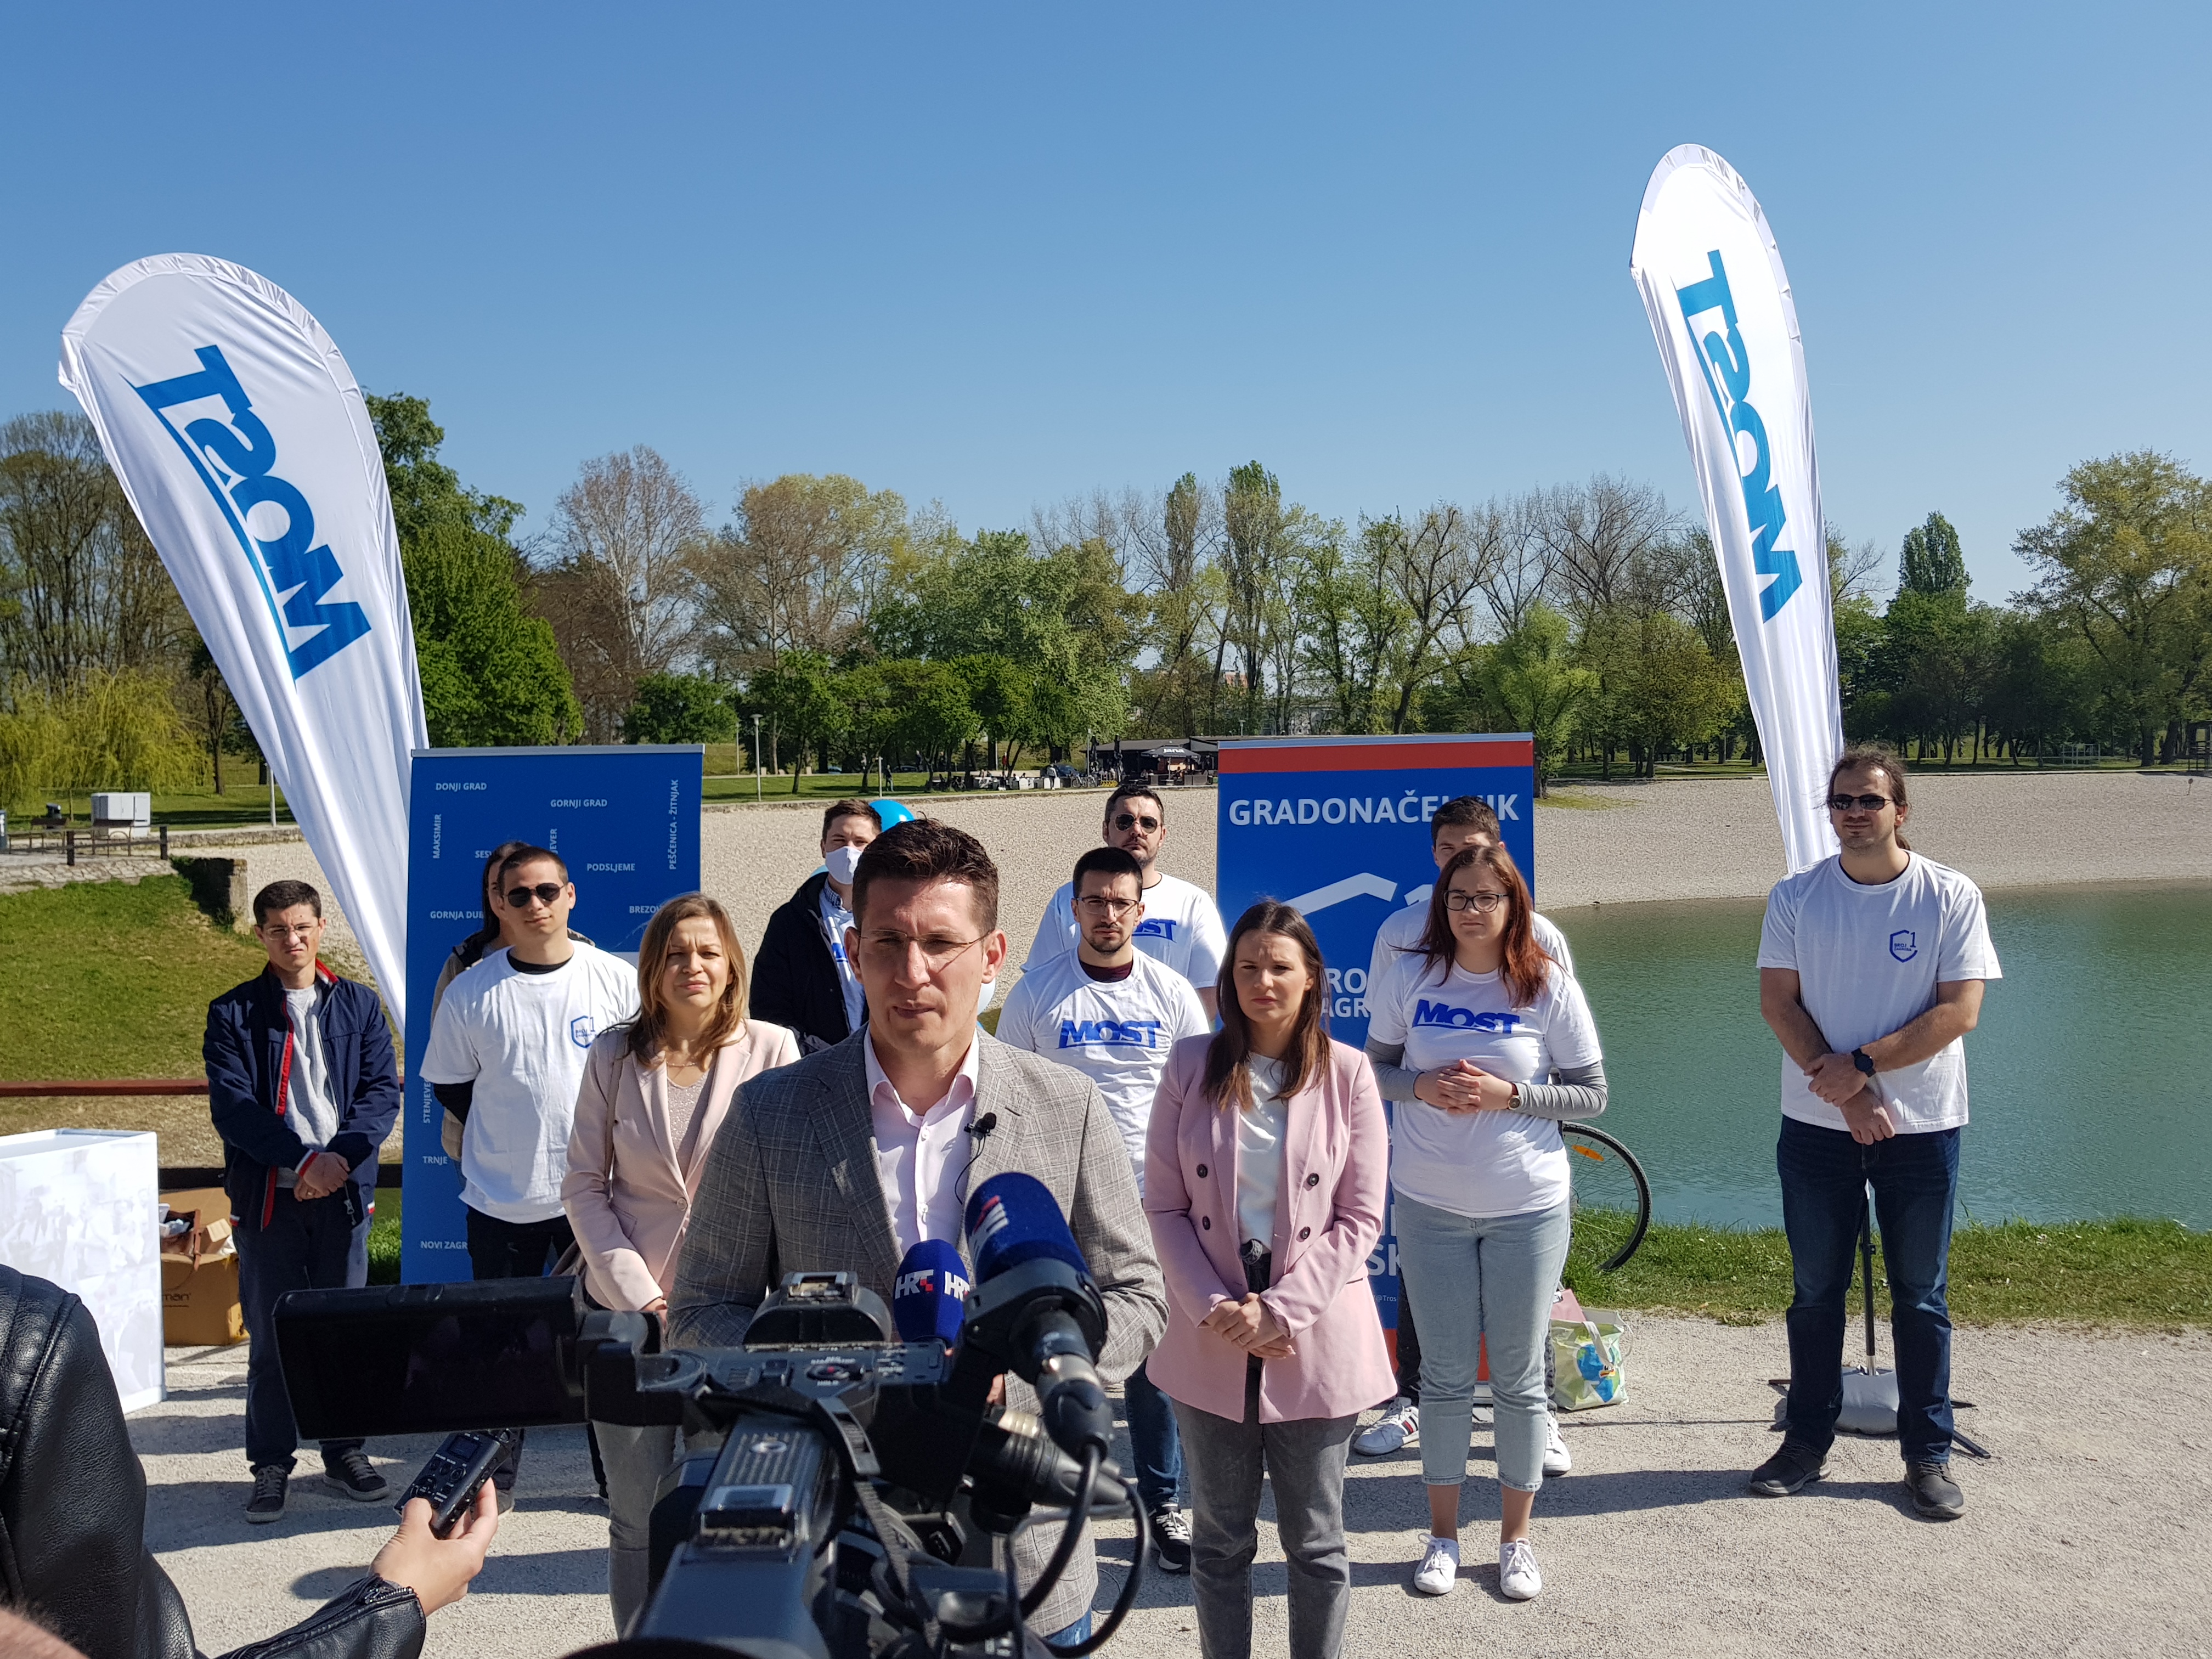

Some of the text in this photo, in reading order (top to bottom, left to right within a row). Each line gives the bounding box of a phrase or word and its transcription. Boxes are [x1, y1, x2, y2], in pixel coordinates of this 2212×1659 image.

[436, 782, 487, 792] DONJI GRAD
[668, 779, 680, 815] ŽITNJAK
[550, 799, 608, 809] GORNJI GRAD
[1229, 789, 1519, 825] GRADONAČEIK
[433, 814, 442, 859] MAKSIMIR
[668, 821, 678, 870] PEŠČENICA
[587, 863, 635, 873] PODSLJEME
[430, 911, 464, 921] GORNJA
[1412, 999, 1520, 1034] MOST
[1058, 1020, 1161, 1049] MOST
[422, 1156, 448, 1165] TRNJE
[421, 1240, 443, 1249] NOVI
[895, 1269, 934, 1300] HRT
